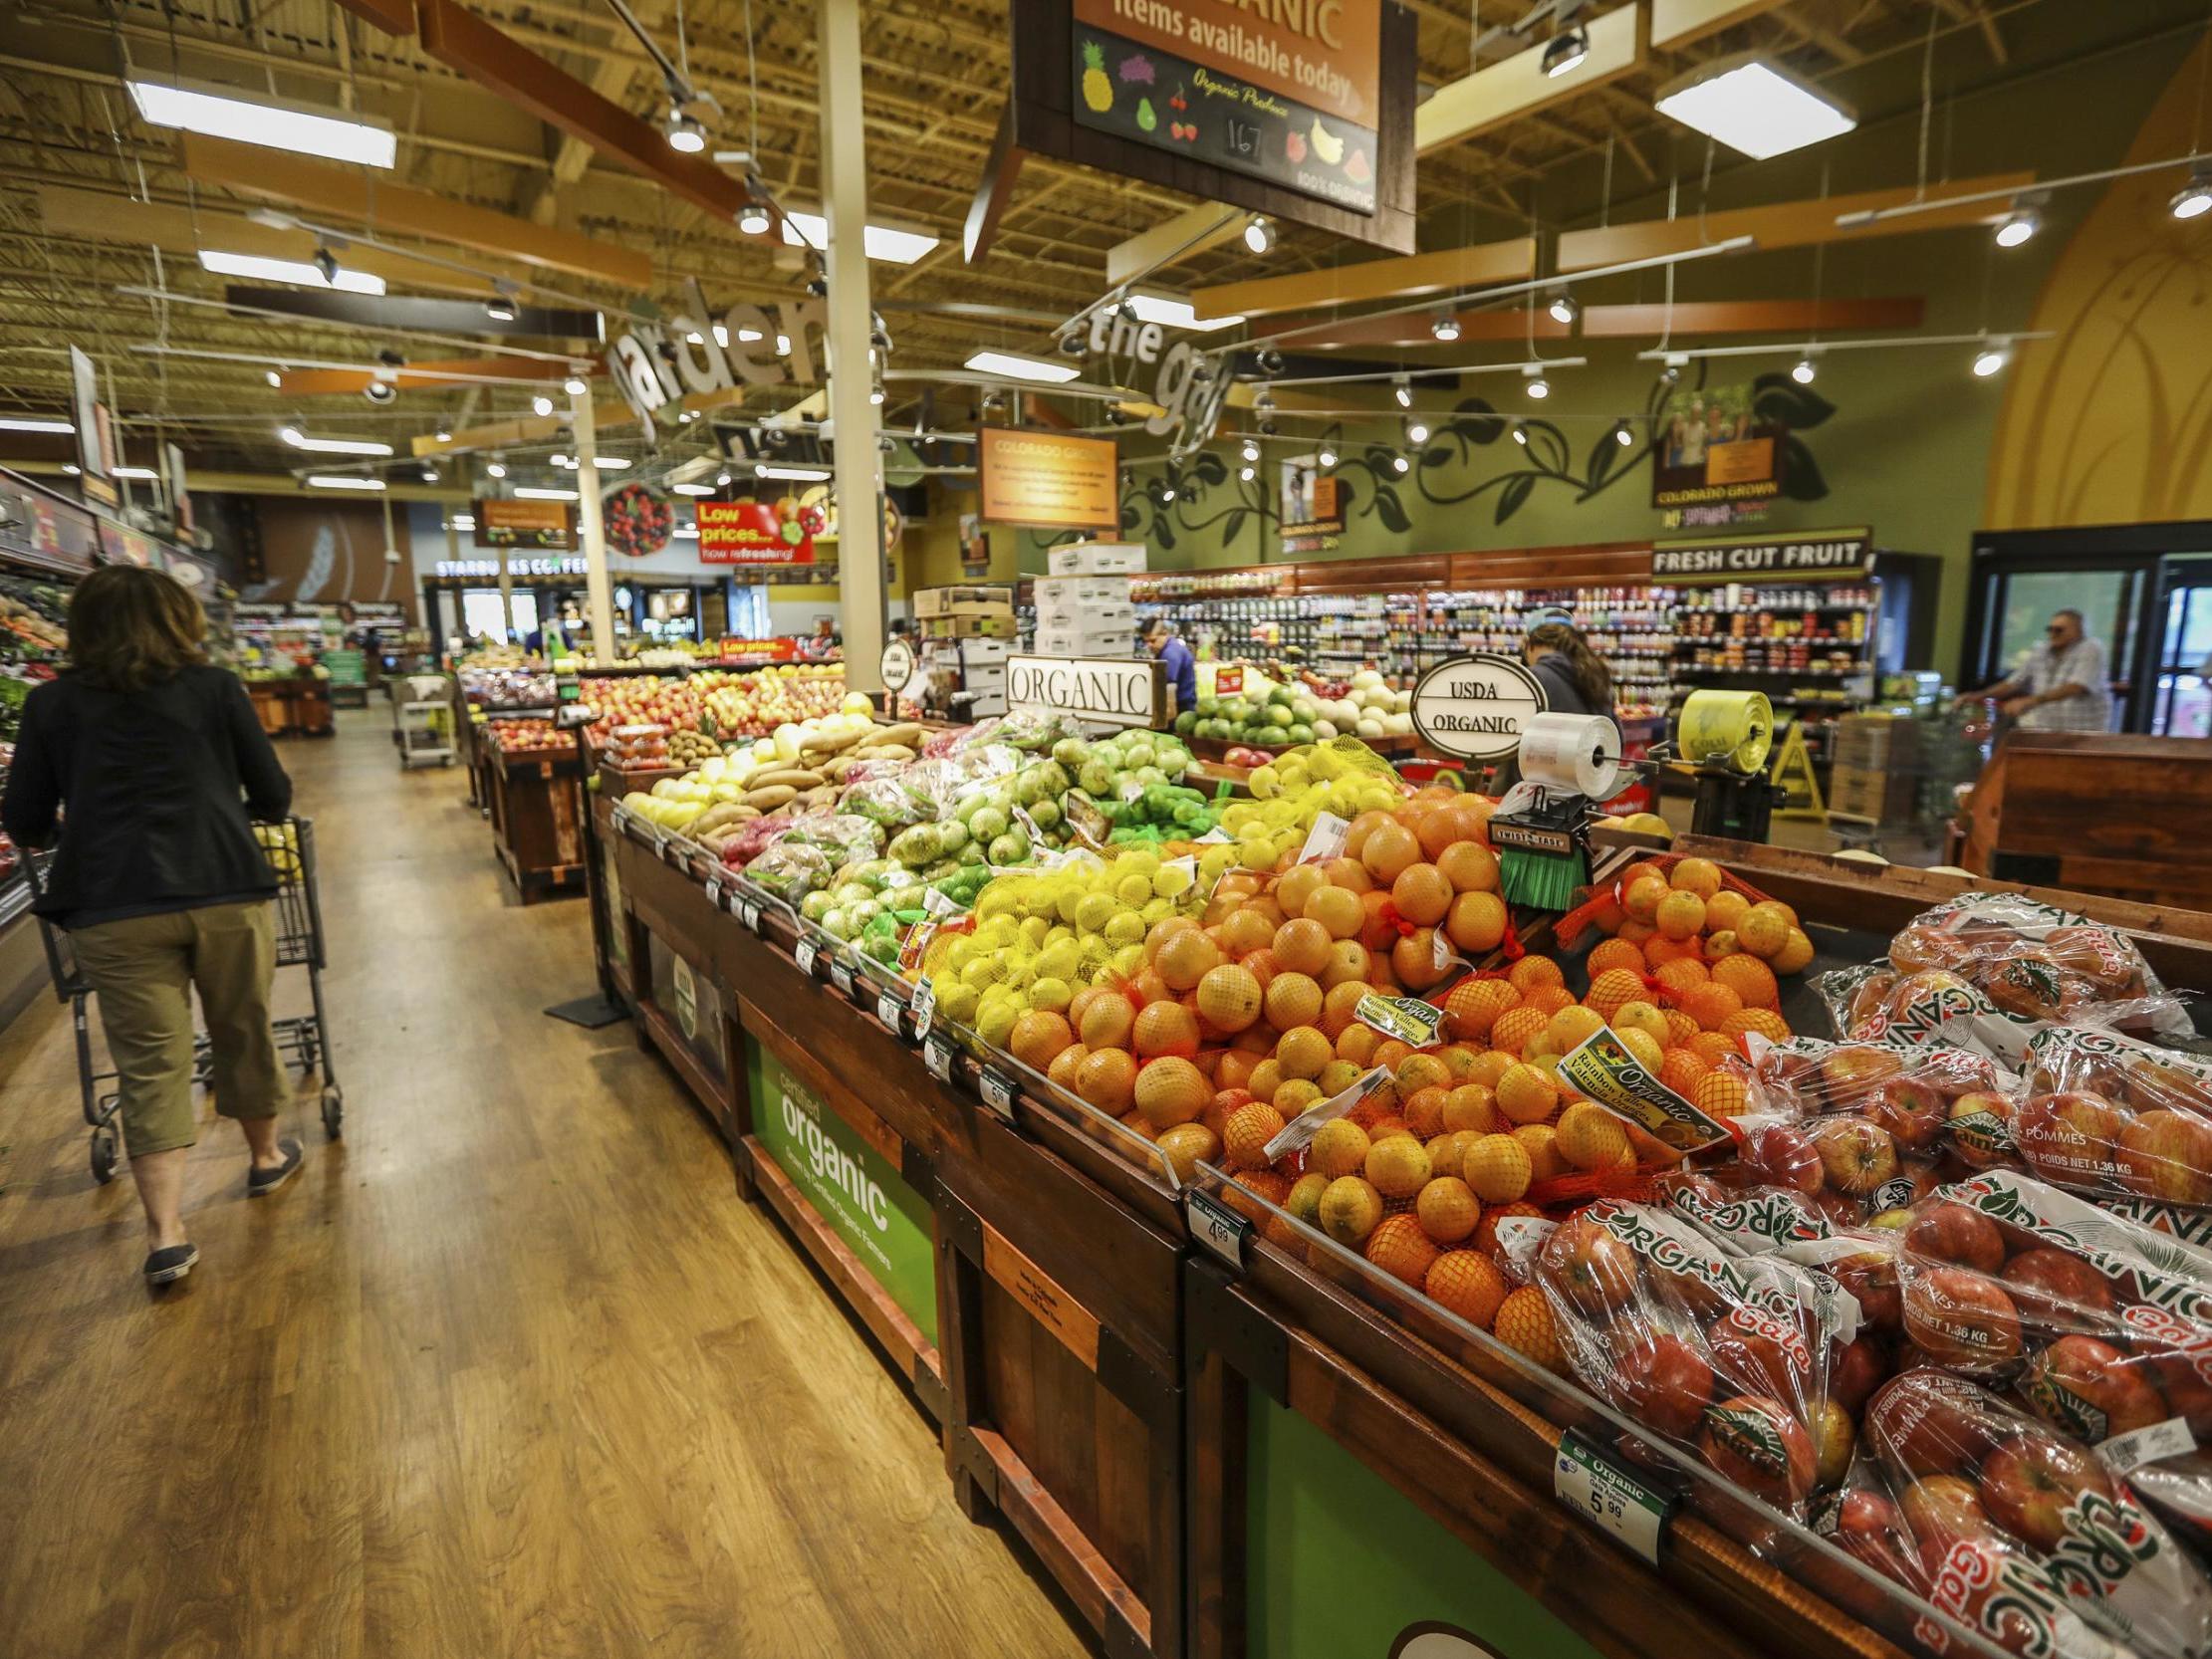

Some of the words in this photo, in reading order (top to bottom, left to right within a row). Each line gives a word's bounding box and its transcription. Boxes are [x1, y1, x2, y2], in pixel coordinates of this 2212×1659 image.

[1188, 17, 1291, 76] available
[1293, 53, 1352, 106] today
[1192, 68, 1241, 99] Organic
[1089, 309, 1164, 363] the
[1656, 487, 1726, 504] COLORADO
[1727, 481, 1779, 498] GROWN
[699, 505, 740, 523] Low
[701, 527, 775, 546] prices...
[1653, 550, 1724, 573] FRESH
[1728, 547, 1779, 569] CUT
[1783, 542, 1861, 566] FRUIT
[1009, 665, 1149, 715] ORGANIC
[1449, 680, 1498, 700] USDA
[1432, 714, 1518, 734] ORGANIC
[1571, 1059, 1609, 1101] Valencia
[1610, 1096, 1652, 1123] Oranges
[1578, 1052, 1618, 1094] Rainbow
[1618, 1089, 1648, 1112] Valley
[1617, 1067, 1691, 1123] Organic
[2025, 1127, 2088, 1146] POMMES
[781, 1093, 888, 1233] organic
[2039, 1153, 2069, 1168] POIDS
[2070, 1157, 2090, 1170] NET
[2092, 1159, 2115, 1173] 1.36
[2115, 1162, 2133, 1175] KG
[1729, 1305, 1813, 1375] Gala
[1903, 1300, 1924, 1319] OIDS
[1922, 1313, 1943, 1329] NET
[1943, 1321, 1969, 1338] 1.36
[1971, 1328, 1989, 1344] KG
[1593, 1459, 1645, 1501] Organic
[1591, 1491, 1602, 1515] 5
[1607, 1501, 1622, 1519] 99
